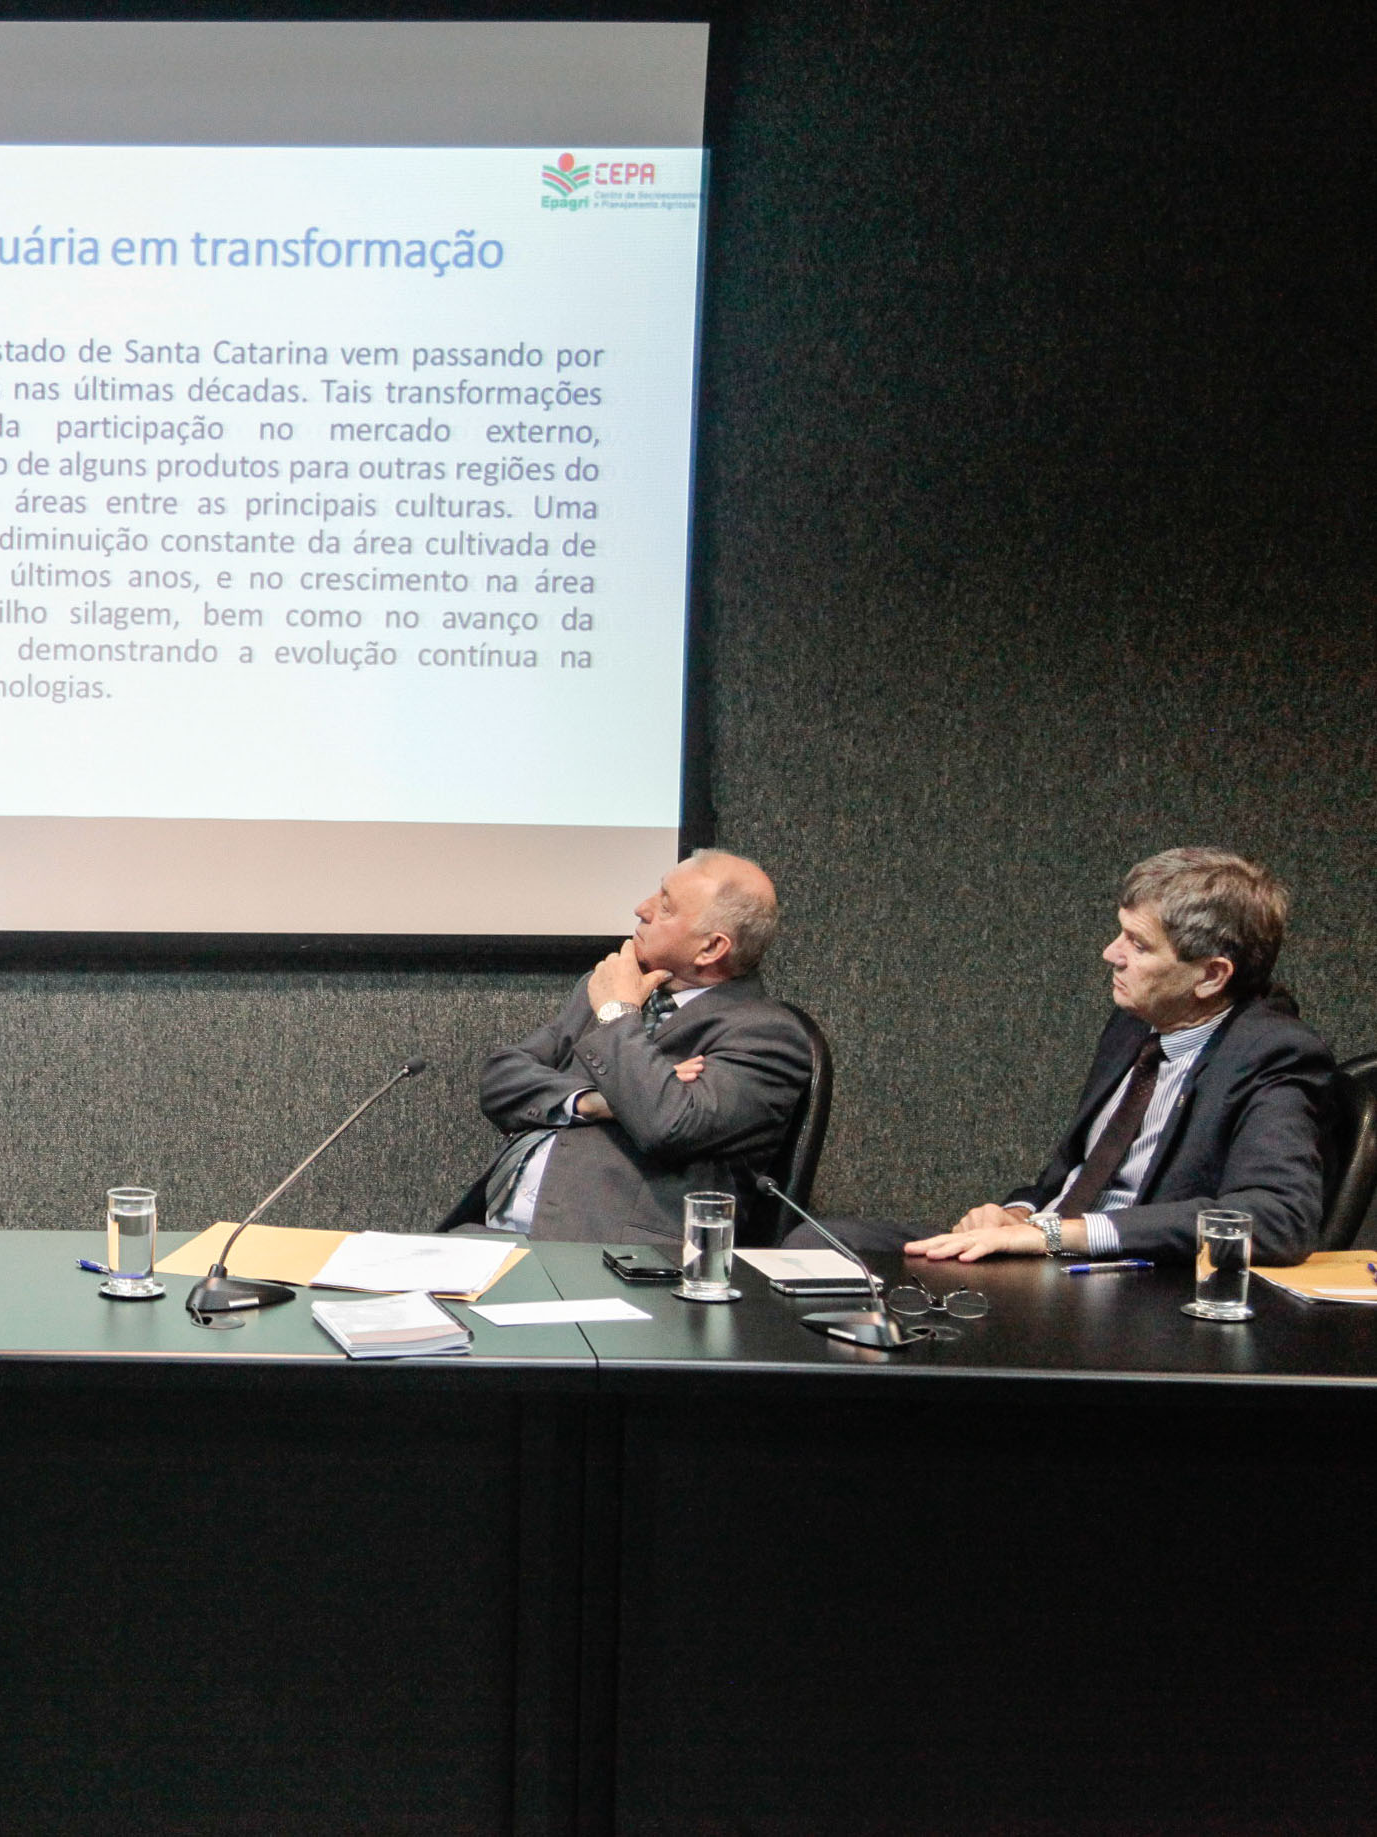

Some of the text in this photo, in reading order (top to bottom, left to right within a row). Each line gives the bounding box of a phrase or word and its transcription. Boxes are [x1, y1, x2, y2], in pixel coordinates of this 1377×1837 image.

[595, 163, 655, 185] CEPA
[541, 196, 590, 212] Epagri
[111, 237, 177, 266] em
[190, 226, 504, 278] transformação
[78, 338, 112, 363] de
[125, 339, 200, 364] Santa
[213, 340, 328, 365] Catarina
[340, 347, 399, 366] vem
[413, 341, 544, 372] passando
[557, 349, 606, 373] por
[14, 382, 60, 401] nas
[74, 375, 174, 402] últimas
[188, 376, 308, 403] décadas.
[320, 379, 373, 404] Tais
[385, 379, 602, 411] transformações
[57, 415, 224, 446] participação
[260, 422, 294, 441] no
[330, 417, 451, 442] mercado
[486, 421, 601, 448] externo,
[17, 450, 50, 476] de
[59, 451, 147, 482] alguns
[157, 452, 280, 483] produtos
[290, 460, 350, 484] para
[359, 457, 447, 480] outras
[456, 456, 557, 486] regiões
[565, 456, 600, 482] do
[15, 488, 87, 514] áreas
[106, 493, 178, 515] entre
[198, 497, 226, 515] as
[246, 492, 377, 522] principais
[395, 492, 513, 519] culturas.
[534, 495, 599, 520] Uma
[0, 525, 148, 557] diminuição
[161, 531, 295, 553] constante
[308, 529, 341, 554] da
[353, 529, 413, 555] área
[425, 530, 550, 556] cultivada
[562, 532, 597, 557] de
[11, 561, 112, 588] últimos
[128, 570, 200, 593] anos,
[217, 571, 233, 589] e
[250, 571, 283, 590] no
[300, 567, 470, 592] crescimento
[486, 575, 518, 593] na
[535, 568, 596, 594] área
[70, 600, 179, 630] silagem,
[204, 601, 263, 627] bem
[286, 609, 362, 628] como
[386, 610, 420, 629] no
[442, 611, 539, 636] avanço
[561, 606, 594, 631] da
[18, 636, 218, 663] demonstrando
[239, 646, 254, 663] a
[275, 640, 398, 671] evolução
[418, 642, 538, 668] contínua
[561, 650, 592, 669] na
